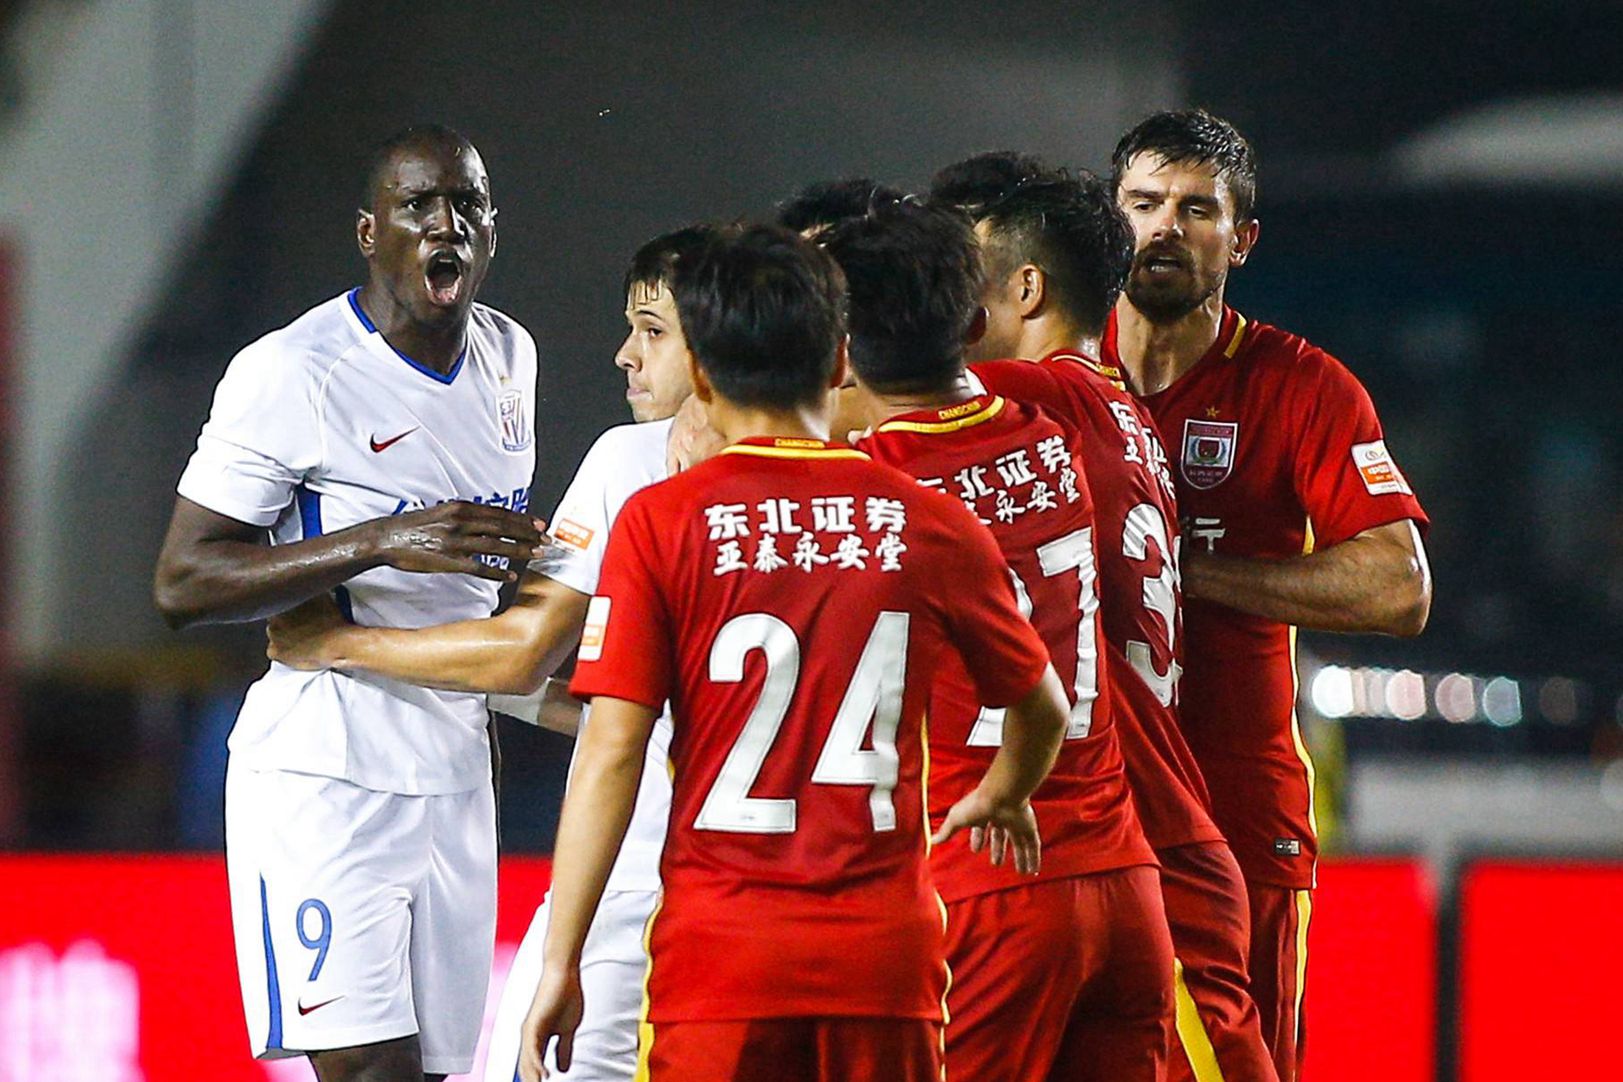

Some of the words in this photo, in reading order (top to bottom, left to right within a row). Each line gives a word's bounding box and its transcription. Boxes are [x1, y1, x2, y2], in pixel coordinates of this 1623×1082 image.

[704, 496, 908, 541] 东北证券
[713, 531, 908, 576] 亚泰永安堂
[693, 611, 910, 833] 24
[296, 898, 332, 981] 9
